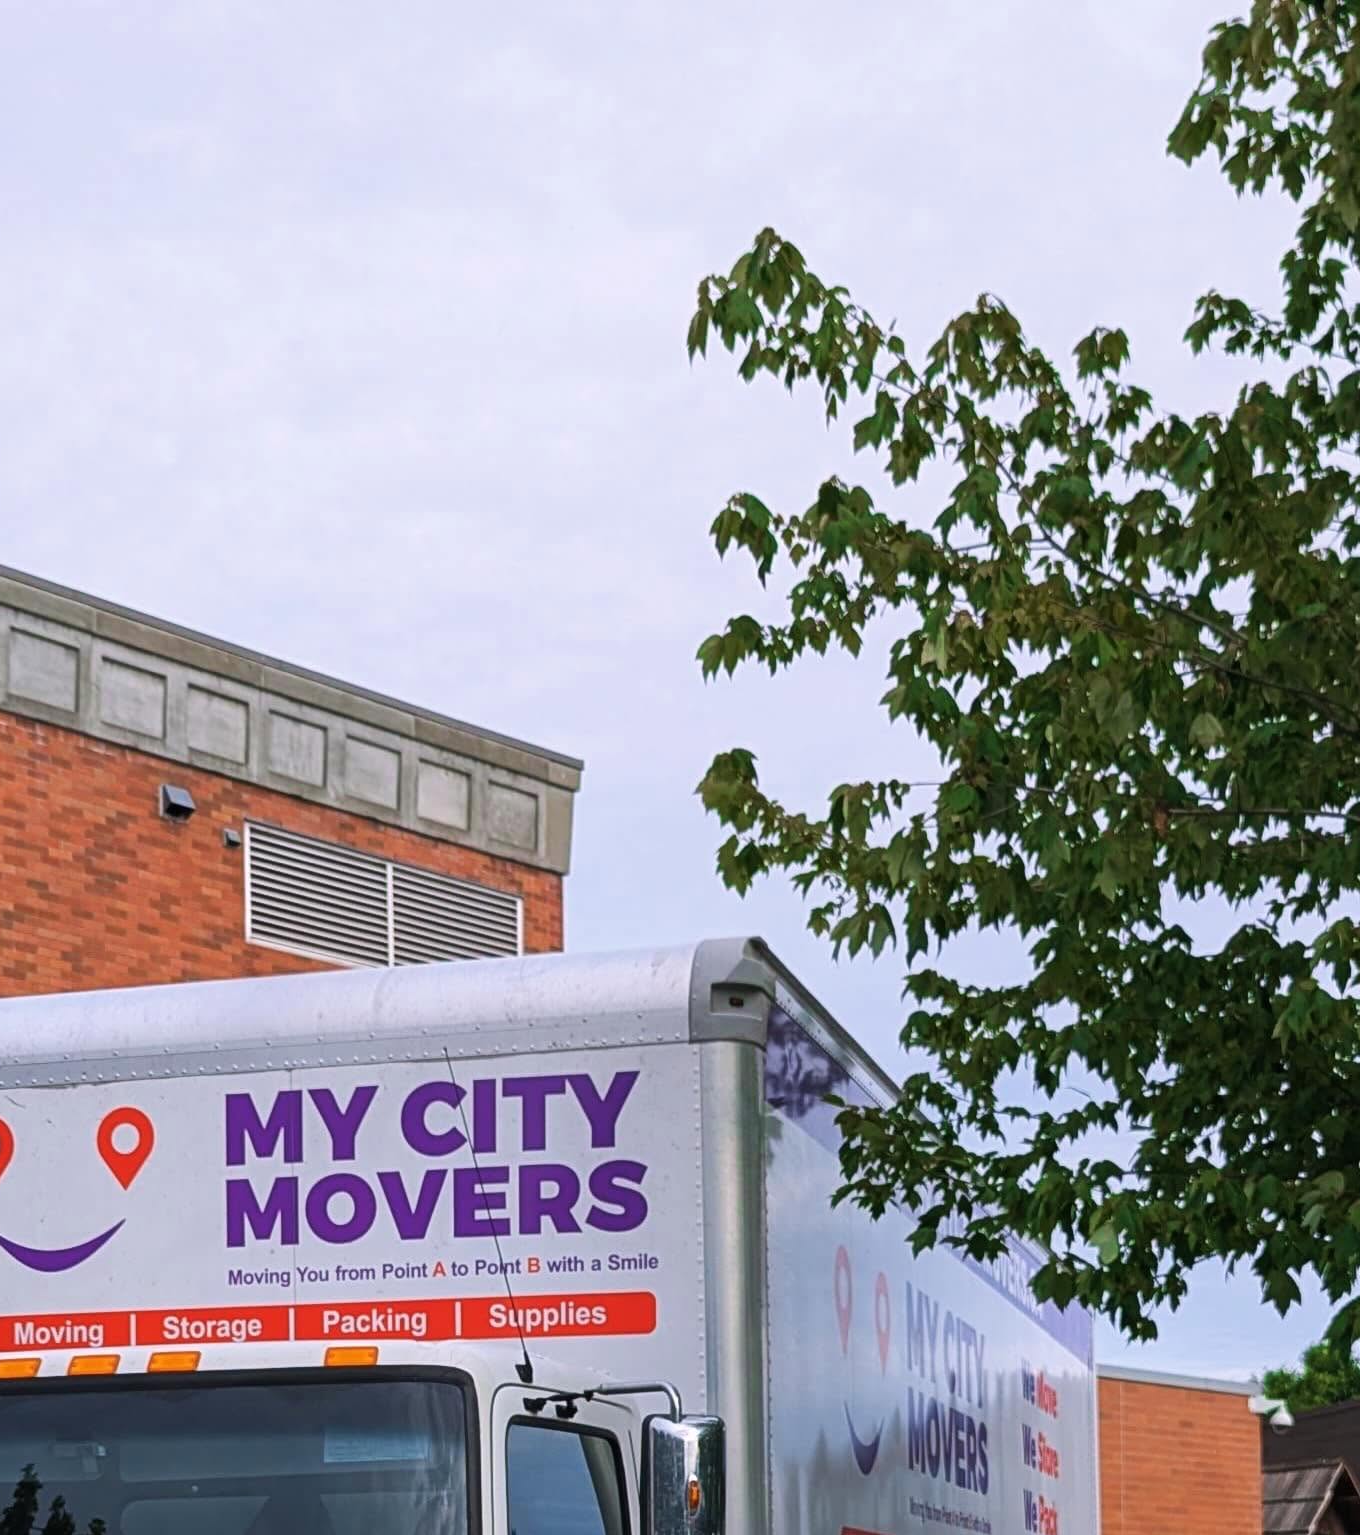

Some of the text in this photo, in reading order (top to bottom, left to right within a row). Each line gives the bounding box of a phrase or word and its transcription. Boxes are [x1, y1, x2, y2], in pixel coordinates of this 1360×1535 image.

[225, 1070, 640, 1165] MY CITY
[225, 1160, 648, 1247] MOVERS
[228, 1254, 659, 1288] Moving You from Point A to Point B with a Smile
[14, 1303, 607, 1347] Moving Storage Packing Supplies
[906, 1281, 984, 1409] MY CITY
[907, 1387, 988, 1495] MOVERS
[1022, 1423, 1036, 1469] We
[1023, 1488, 1037, 1533] We
